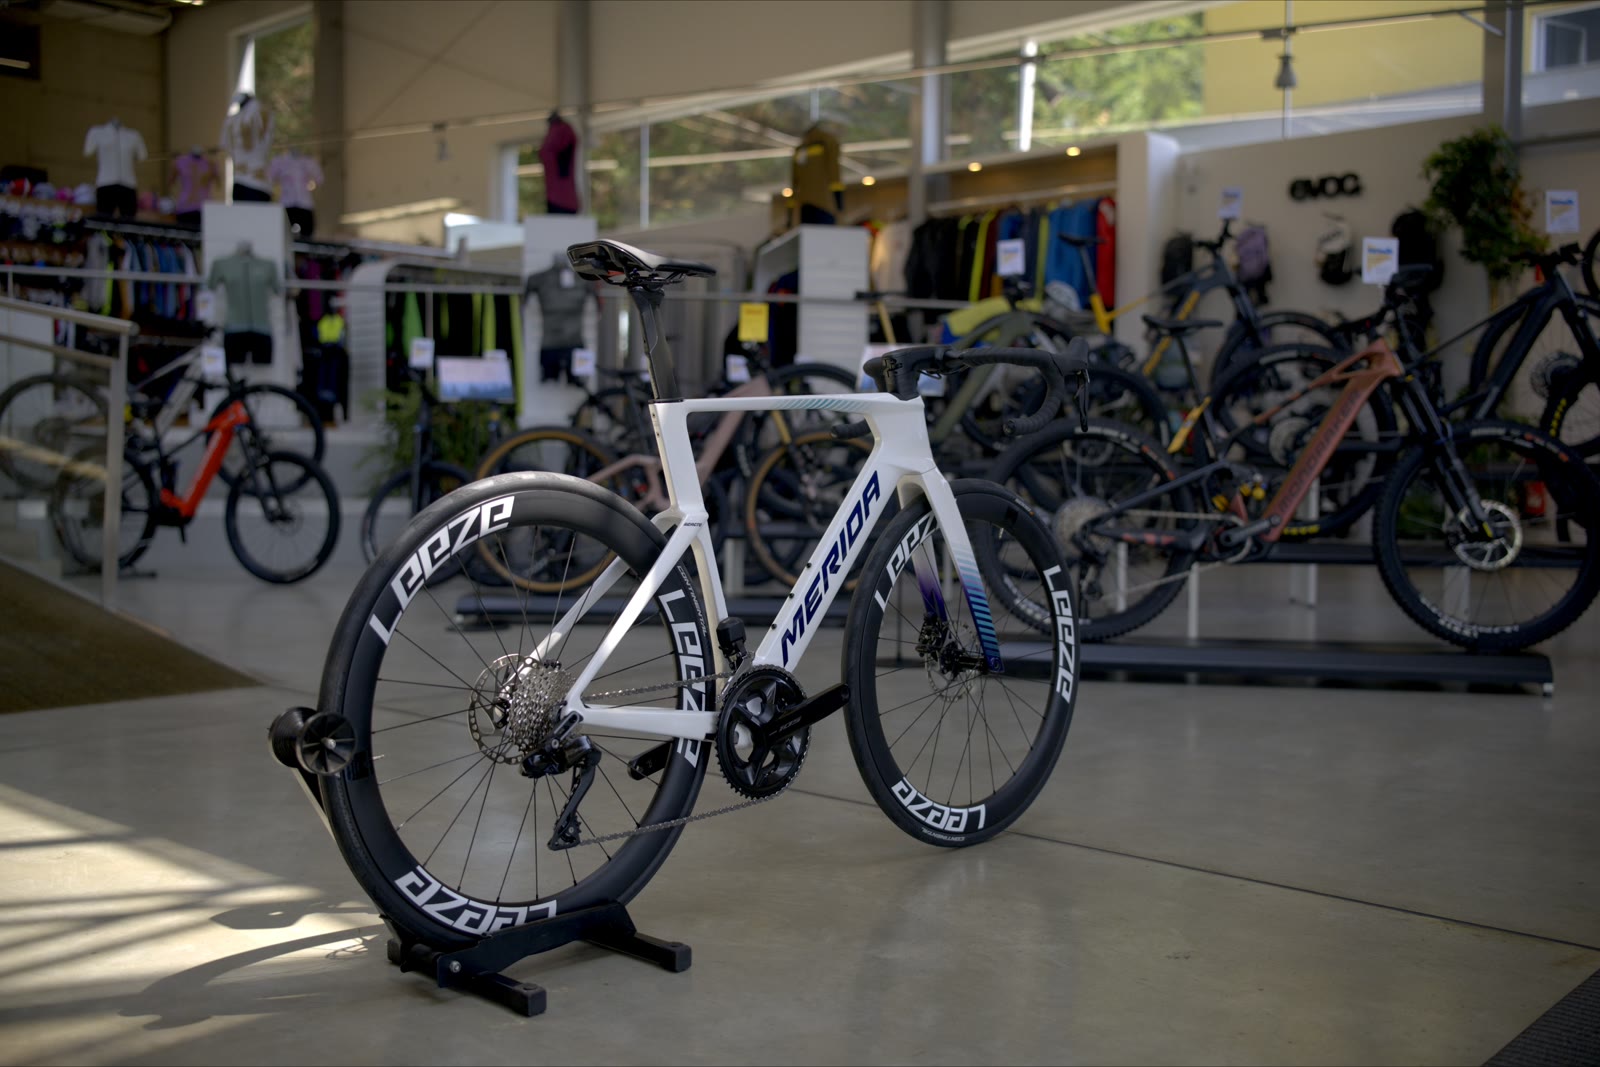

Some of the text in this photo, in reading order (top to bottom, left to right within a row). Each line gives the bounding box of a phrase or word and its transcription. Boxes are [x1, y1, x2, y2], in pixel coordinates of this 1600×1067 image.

[677, 565, 708, 637] CONTINENTAL
[781, 470, 881, 668] MERIDA
[874, 510, 938, 612] Leez
